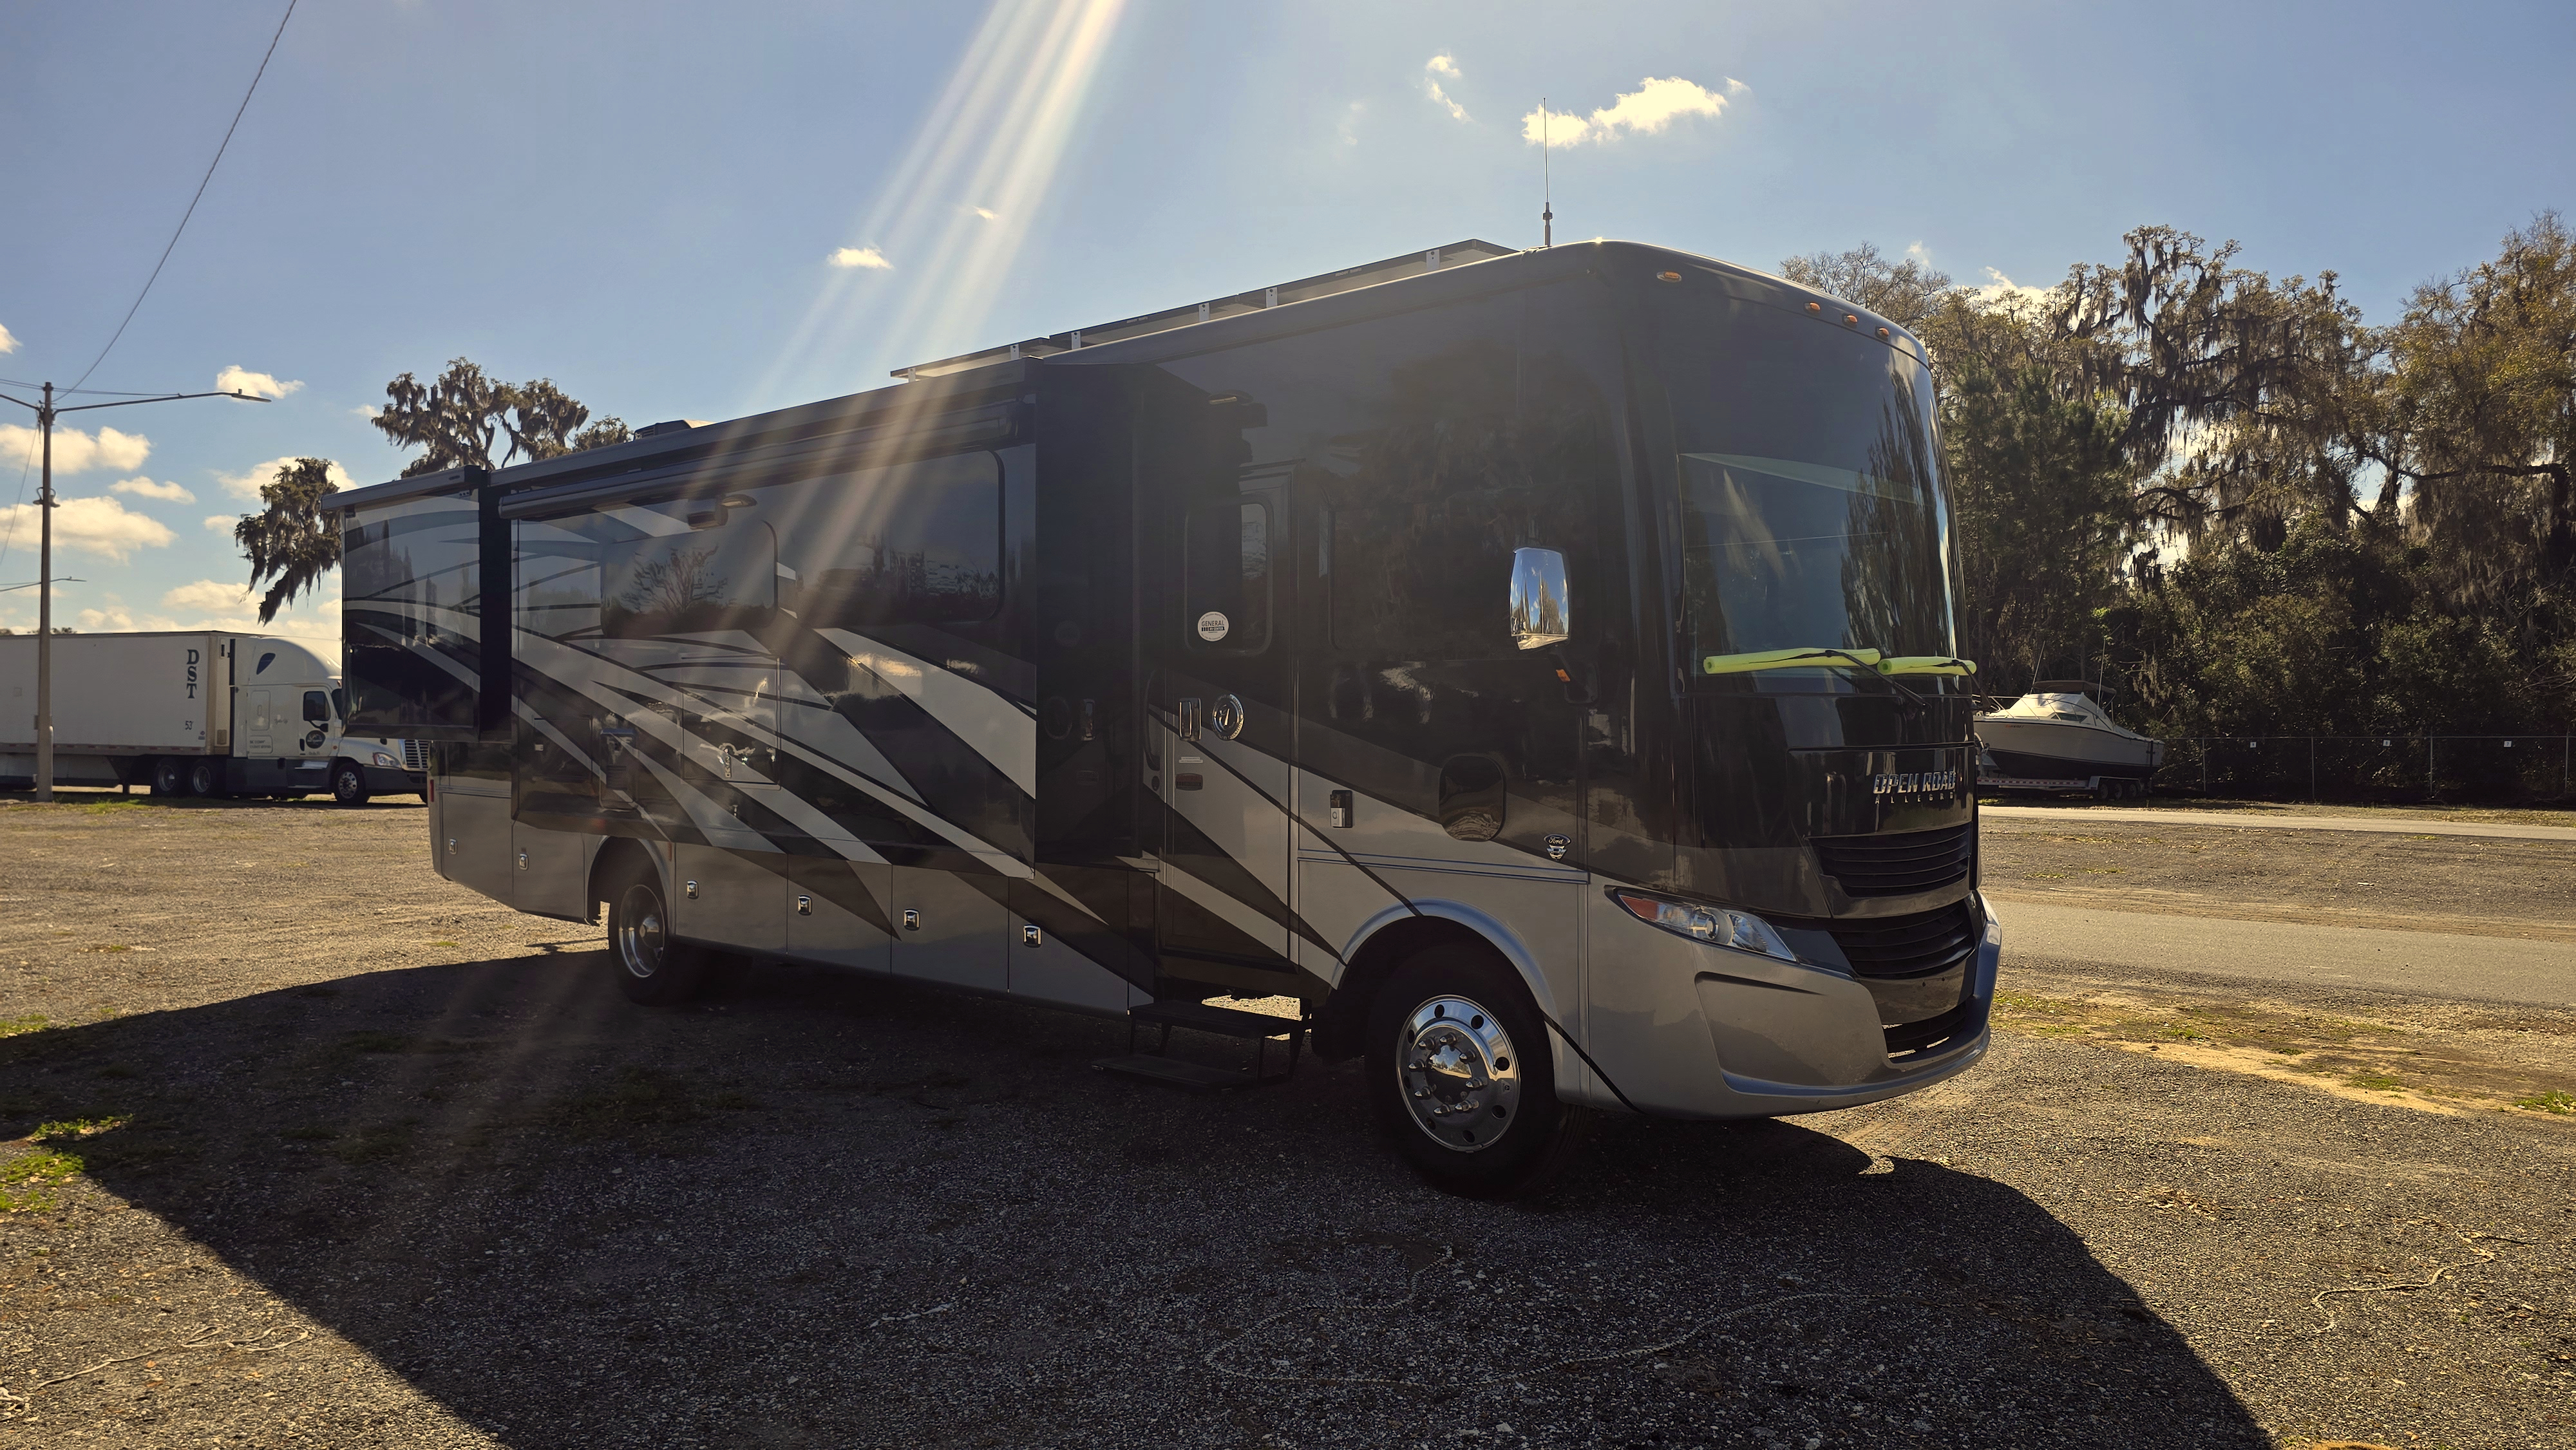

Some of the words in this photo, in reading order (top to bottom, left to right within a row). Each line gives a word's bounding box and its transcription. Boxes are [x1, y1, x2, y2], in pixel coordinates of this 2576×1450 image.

[186, 649, 200, 699] DST
[1873, 773, 1919, 794] OPEN
[1922, 771, 1956, 792] ROAD
[1875, 792, 1953, 804] ALLEGRO
